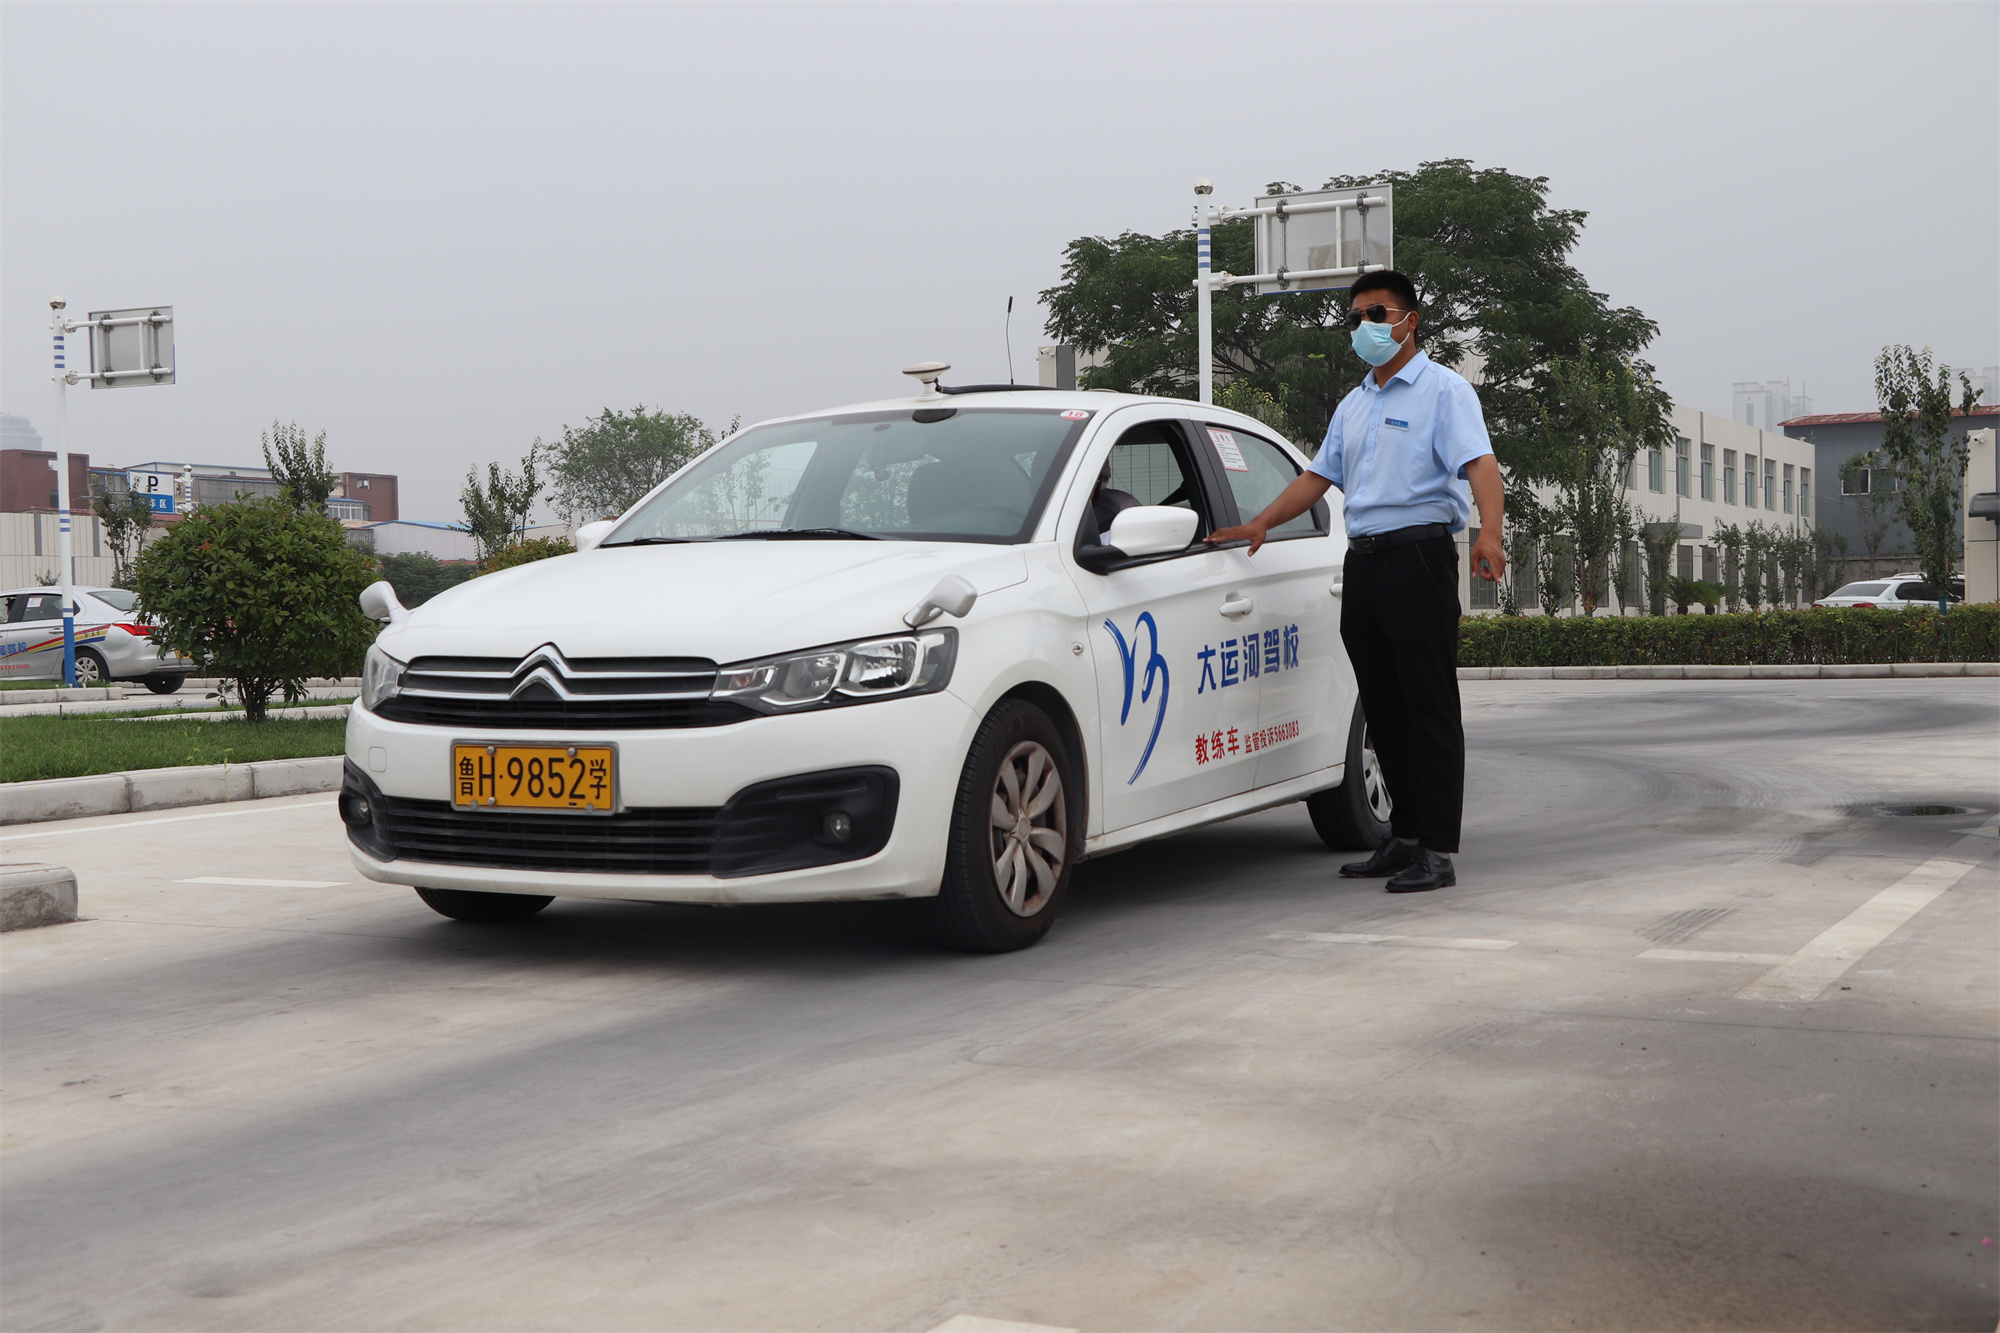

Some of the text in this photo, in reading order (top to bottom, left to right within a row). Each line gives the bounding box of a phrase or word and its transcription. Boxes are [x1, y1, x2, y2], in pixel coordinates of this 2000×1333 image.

[148, 476, 158, 492] P
[1197, 624, 1299, 694] 大运河驾校
[1195, 726, 1240, 765] 教练车
